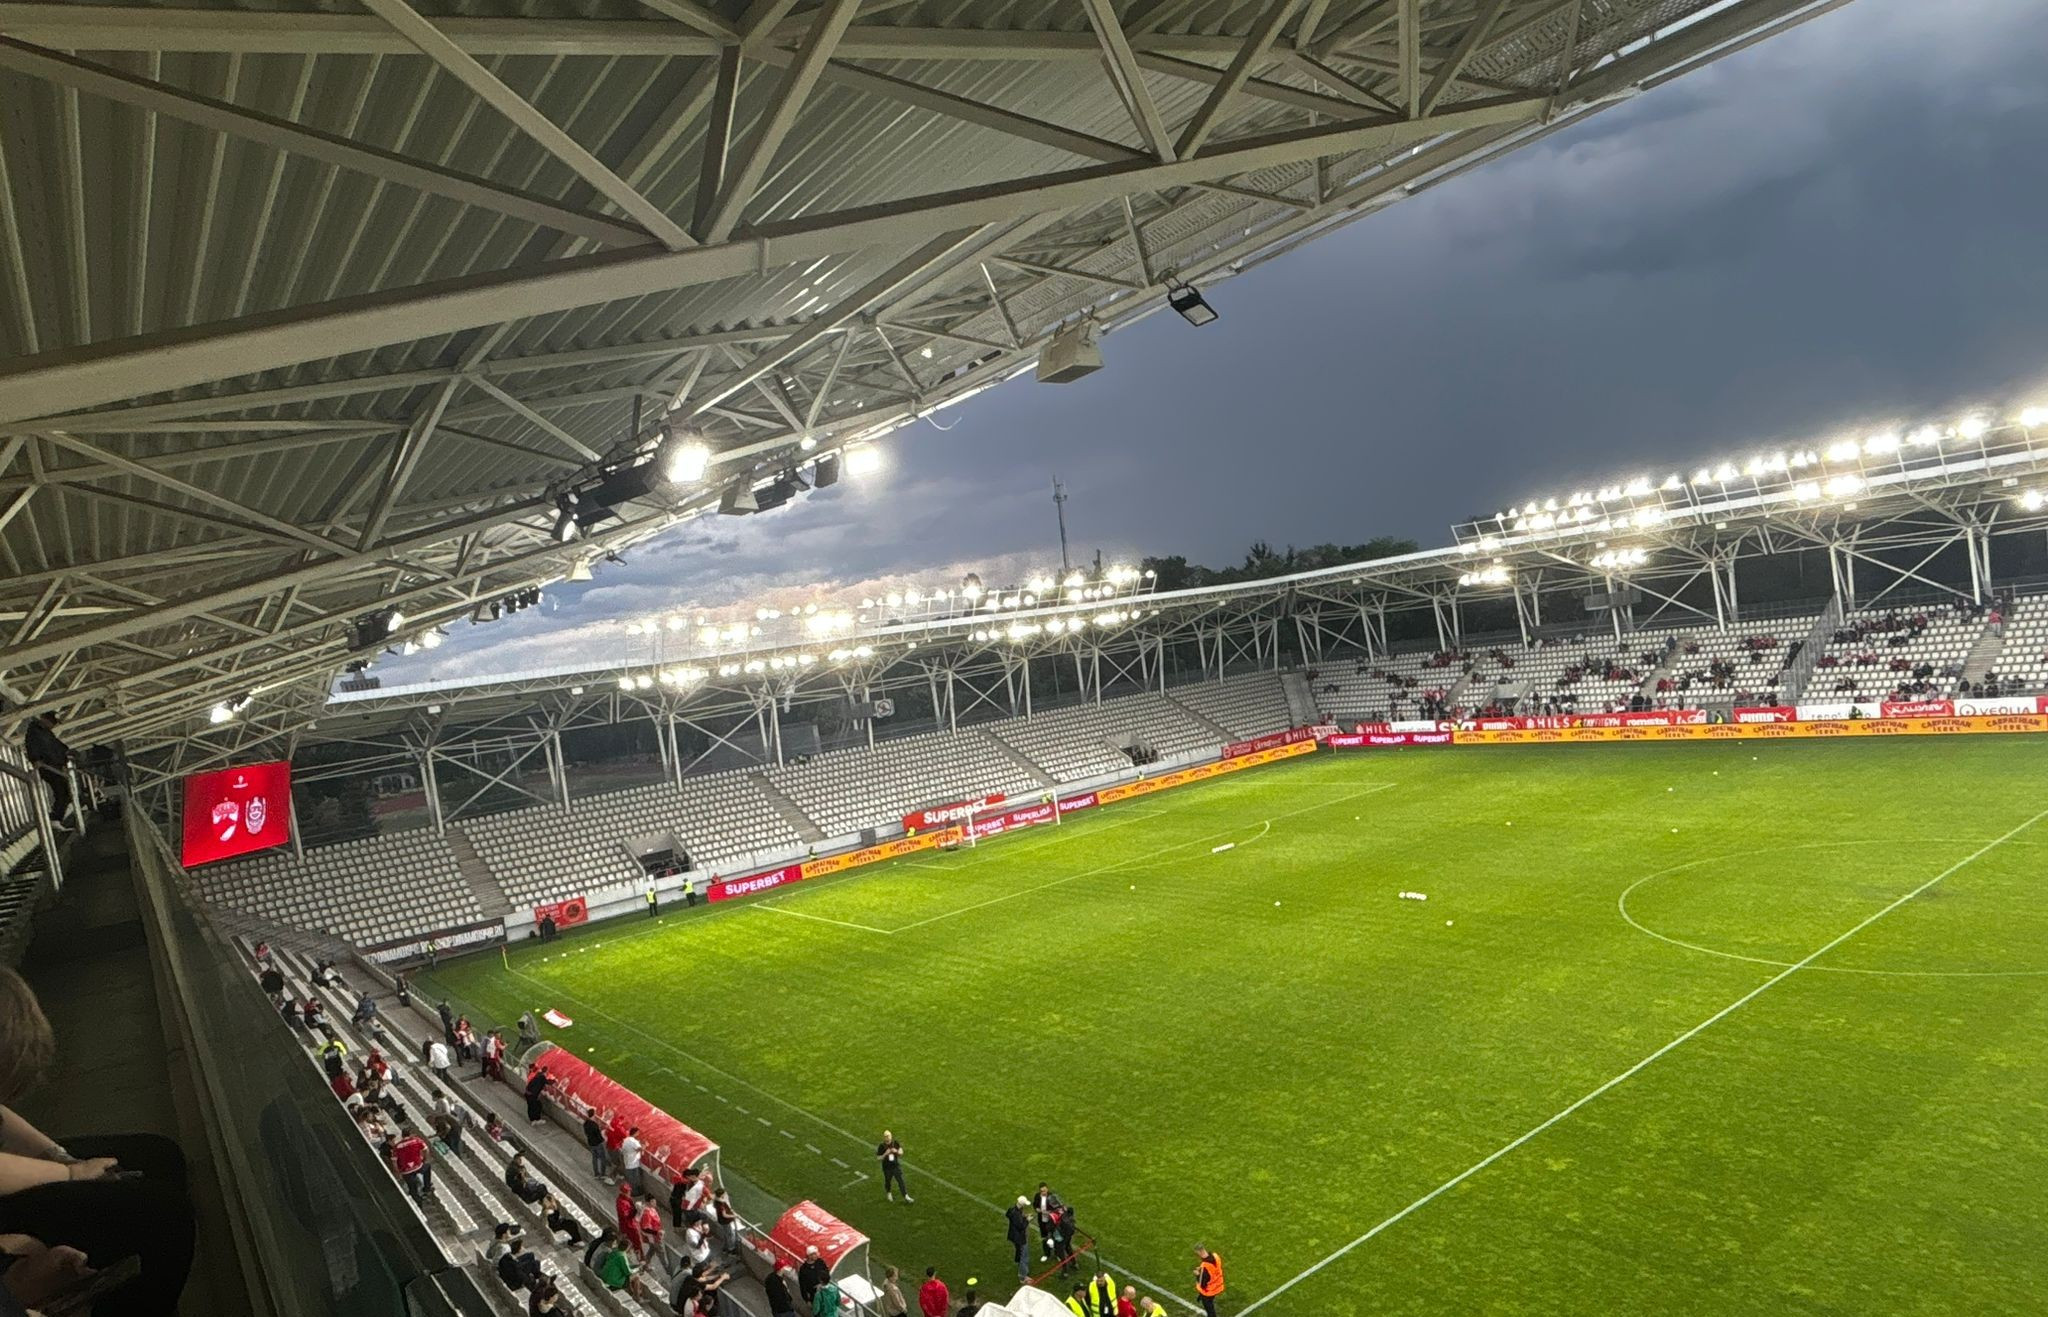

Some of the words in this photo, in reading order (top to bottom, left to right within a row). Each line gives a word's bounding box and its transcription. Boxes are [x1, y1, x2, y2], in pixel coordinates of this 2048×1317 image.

[1537, 717, 1570, 729] HILS
[924, 799, 987, 824] SUPERBET
[1059, 795, 1095, 811] SUPERBET
[725, 870, 786, 895] SUPERBET
